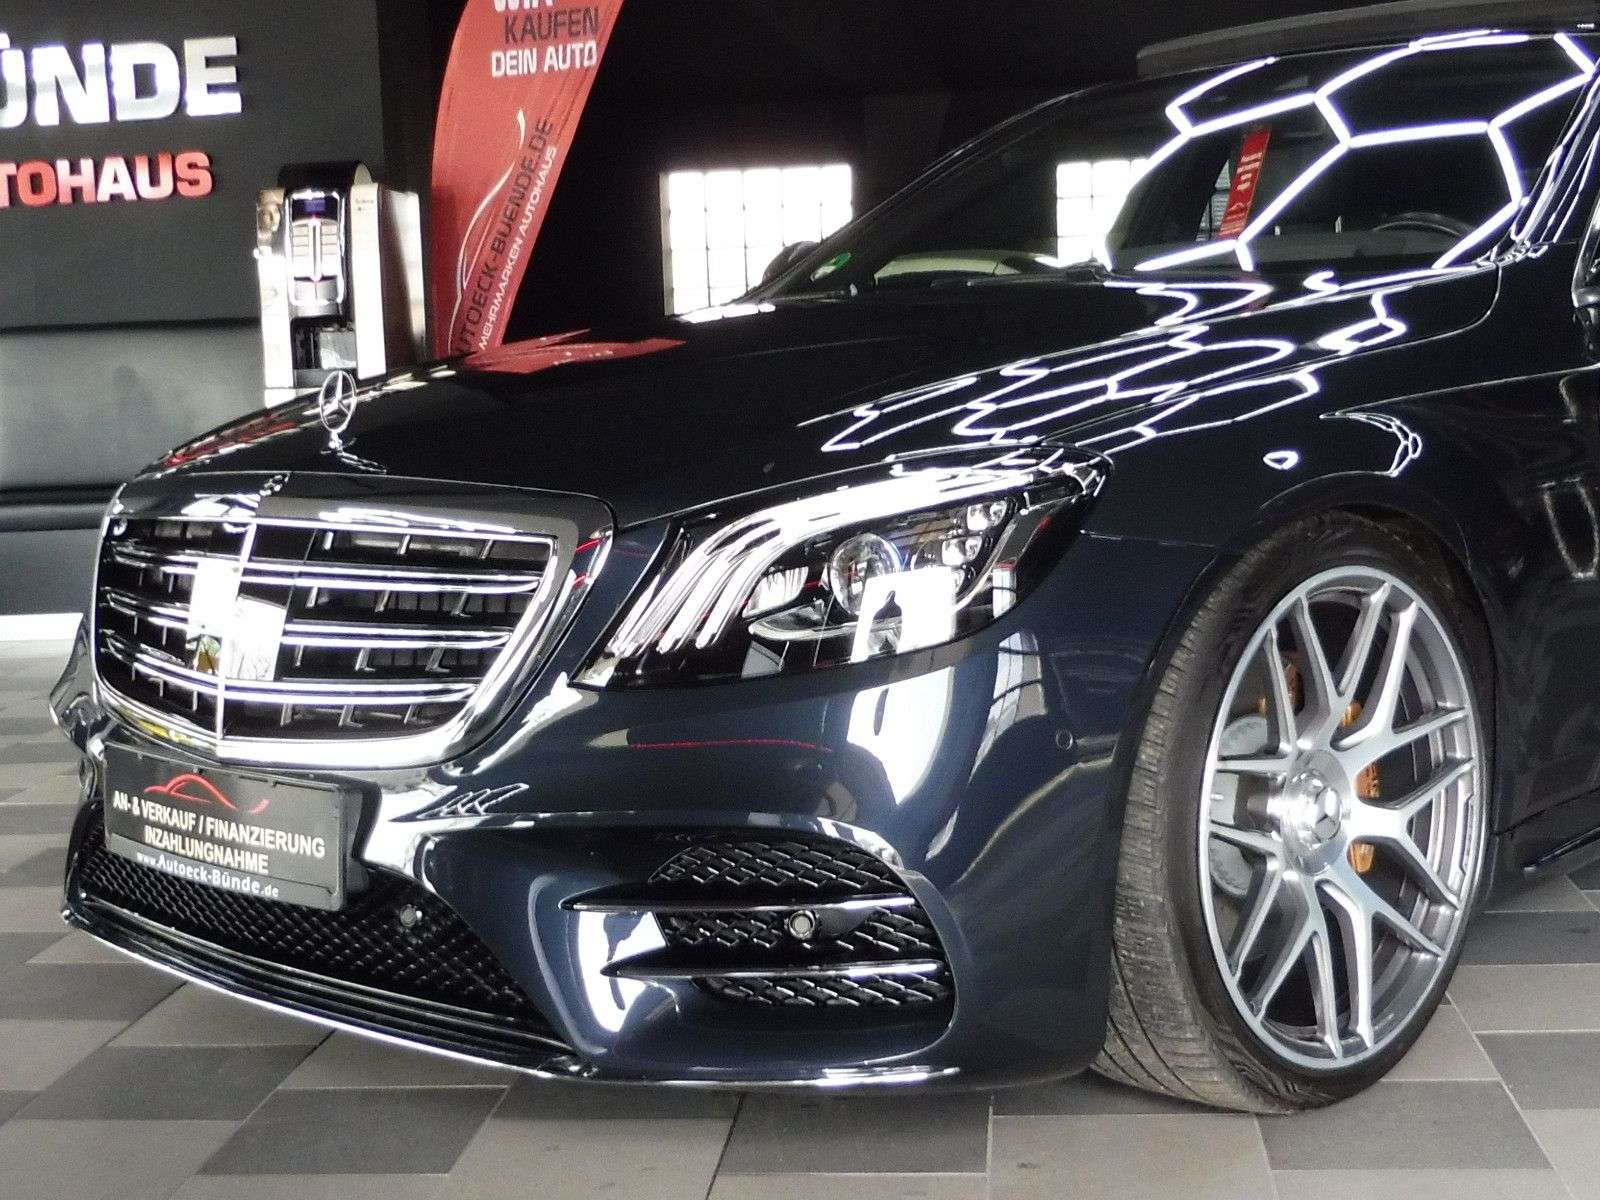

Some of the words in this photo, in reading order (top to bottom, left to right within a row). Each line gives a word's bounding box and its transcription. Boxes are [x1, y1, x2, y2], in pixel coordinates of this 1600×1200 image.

[504, 7, 599, 43] KAUFEN
[491, 47, 538, 78] DEIN
[543, 39, 598, 73] AUTO
[459, 117, 553, 346] TOECK-BUENDE.DE
[479, 237, 524, 351] MEHRMARKEN
[518, 145, 557, 237] AUTOHAUS
[132, 796, 140, 816] &
[141, 799, 197, 832] VERKAUF
[206, 816, 325, 858] FINANZIERUNG
[144, 824, 269, 875] INZAHLUNGNAHME
